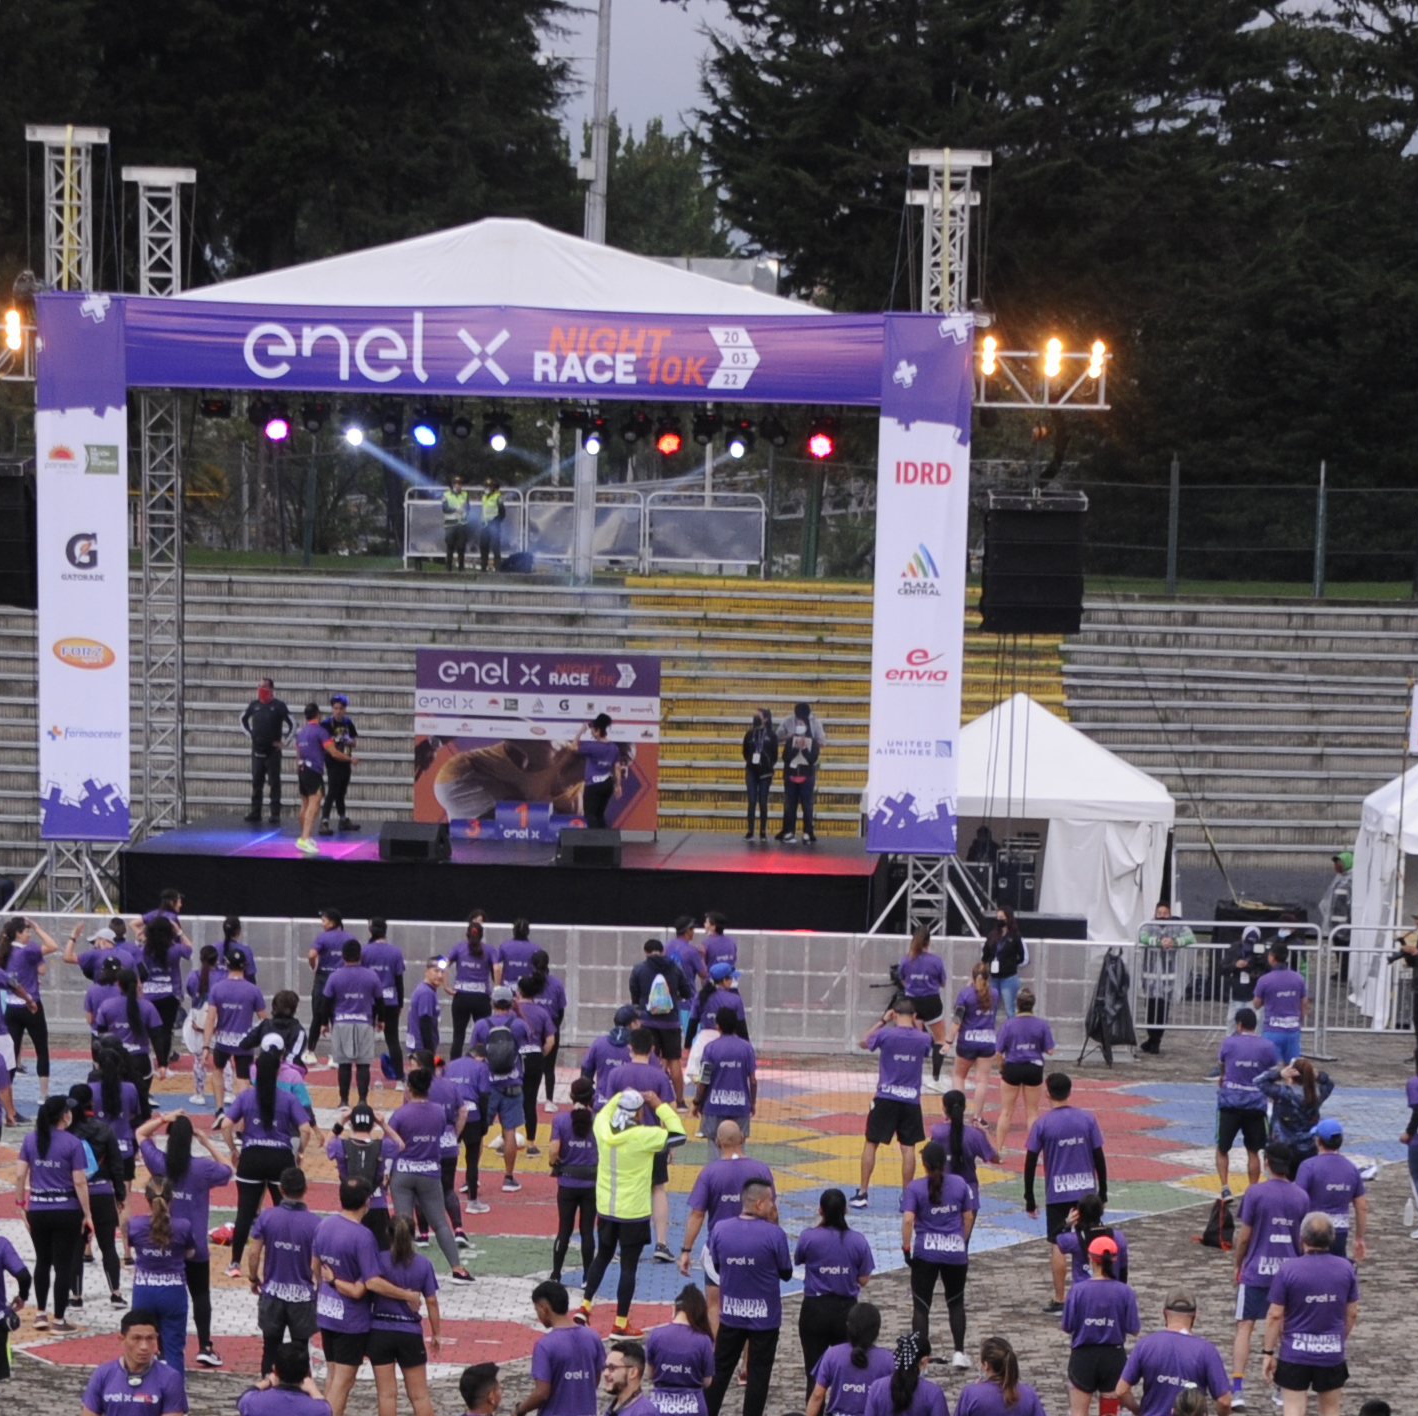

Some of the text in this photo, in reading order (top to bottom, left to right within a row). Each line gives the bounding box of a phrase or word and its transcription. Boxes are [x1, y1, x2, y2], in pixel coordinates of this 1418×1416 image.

[548, 326, 672, 356] NIGHT
[723, 330, 740, 343] 20
[244, 311, 511, 385] enel x
[732, 353, 748, 365] 03
[534, 351, 707, 385] RACE 10K
[723, 374, 739, 385] 22
[896, 461, 952, 485] IDRD
[904, 581, 935, 589] PLAZA
[898, 588, 941, 596] CENTRAL
[439, 657, 510, 685] enel
[885, 669, 948, 681] envia
[549, 672, 589, 686] RACE
[419, 695, 456, 709] enel
[503, 828, 528, 839] enel
[104, 1393, 122, 1403] enel
